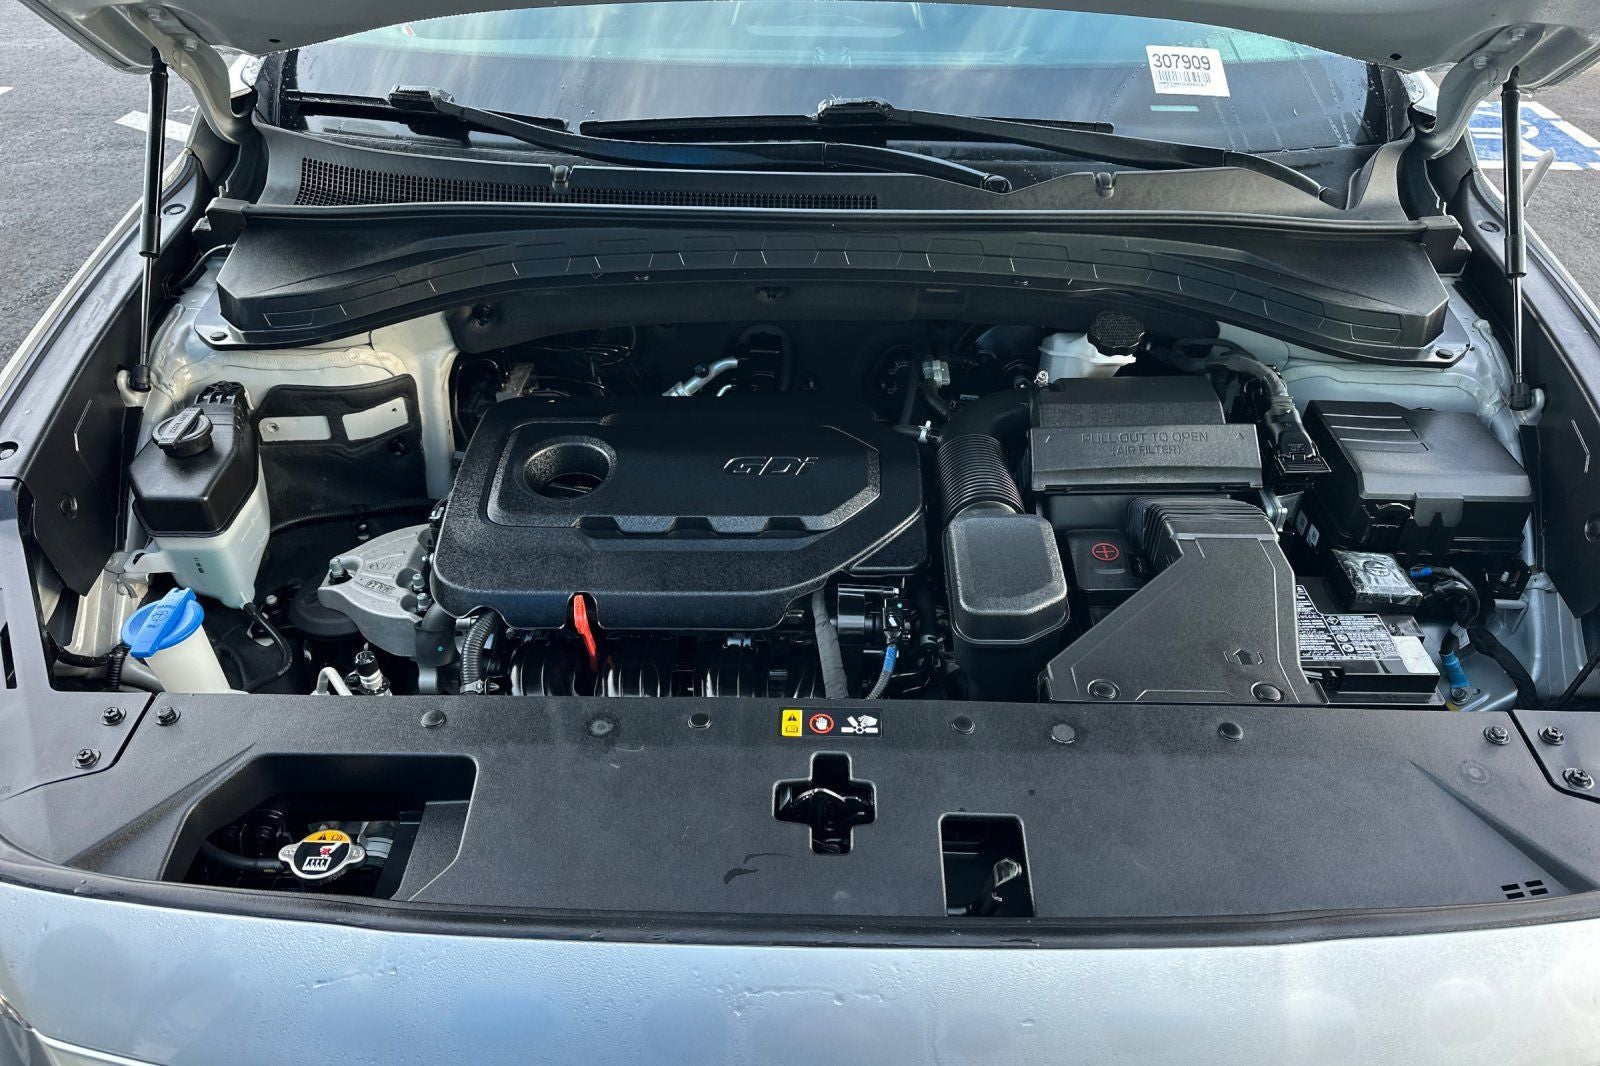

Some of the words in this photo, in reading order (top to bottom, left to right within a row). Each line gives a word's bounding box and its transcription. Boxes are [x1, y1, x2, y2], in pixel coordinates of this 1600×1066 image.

[1152, 53, 1211, 71] 307909
[1081, 433, 1115, 444] PULL
[1118, 433, 1145, 443] OUT
[1152, 432, 1168, 443] TO
[1172, 432, 1208, 443] OPEN
